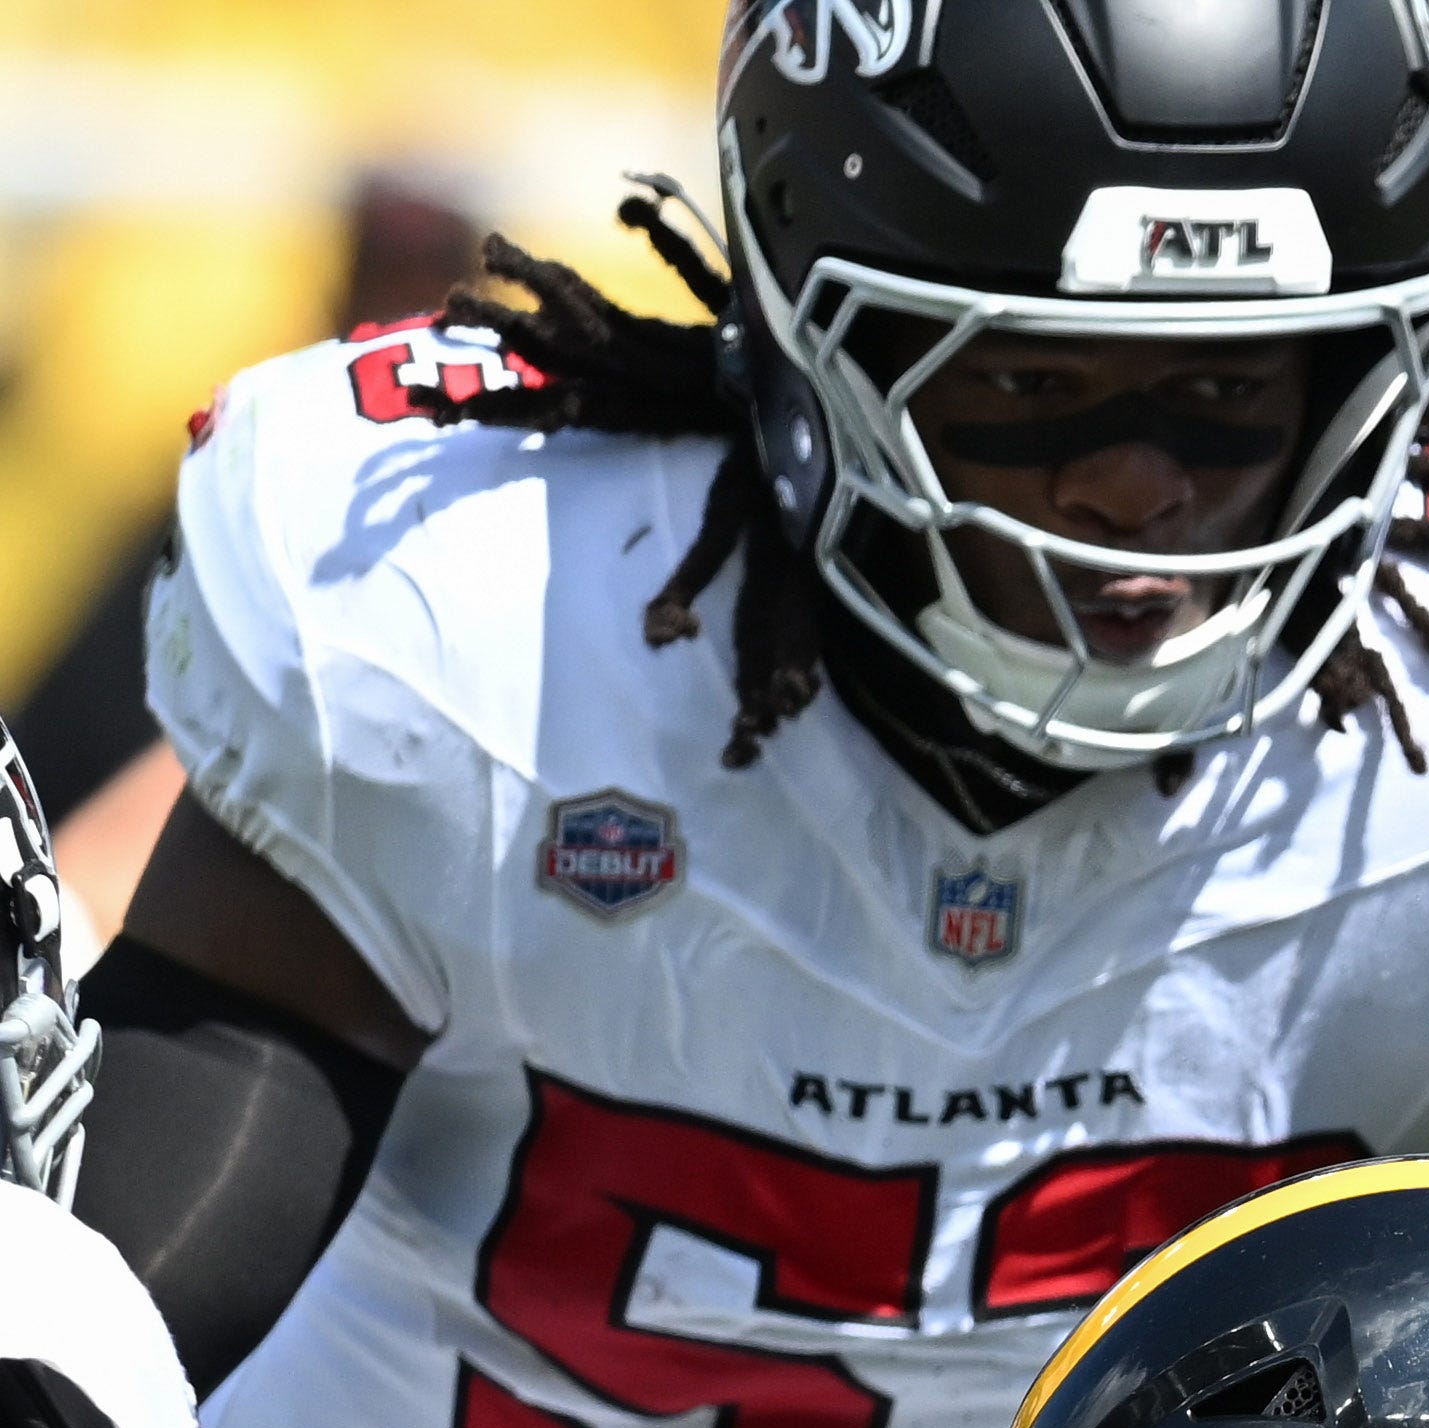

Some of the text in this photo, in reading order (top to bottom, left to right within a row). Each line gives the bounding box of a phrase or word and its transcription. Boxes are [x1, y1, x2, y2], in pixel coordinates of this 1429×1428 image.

[1141, 216, 1274, 275] ATL
[555, 849, 665, 877] DEBUT
[944, 907, 1005, 953] NFL
[790, 1073, 1147, 1124] ATLANTA
